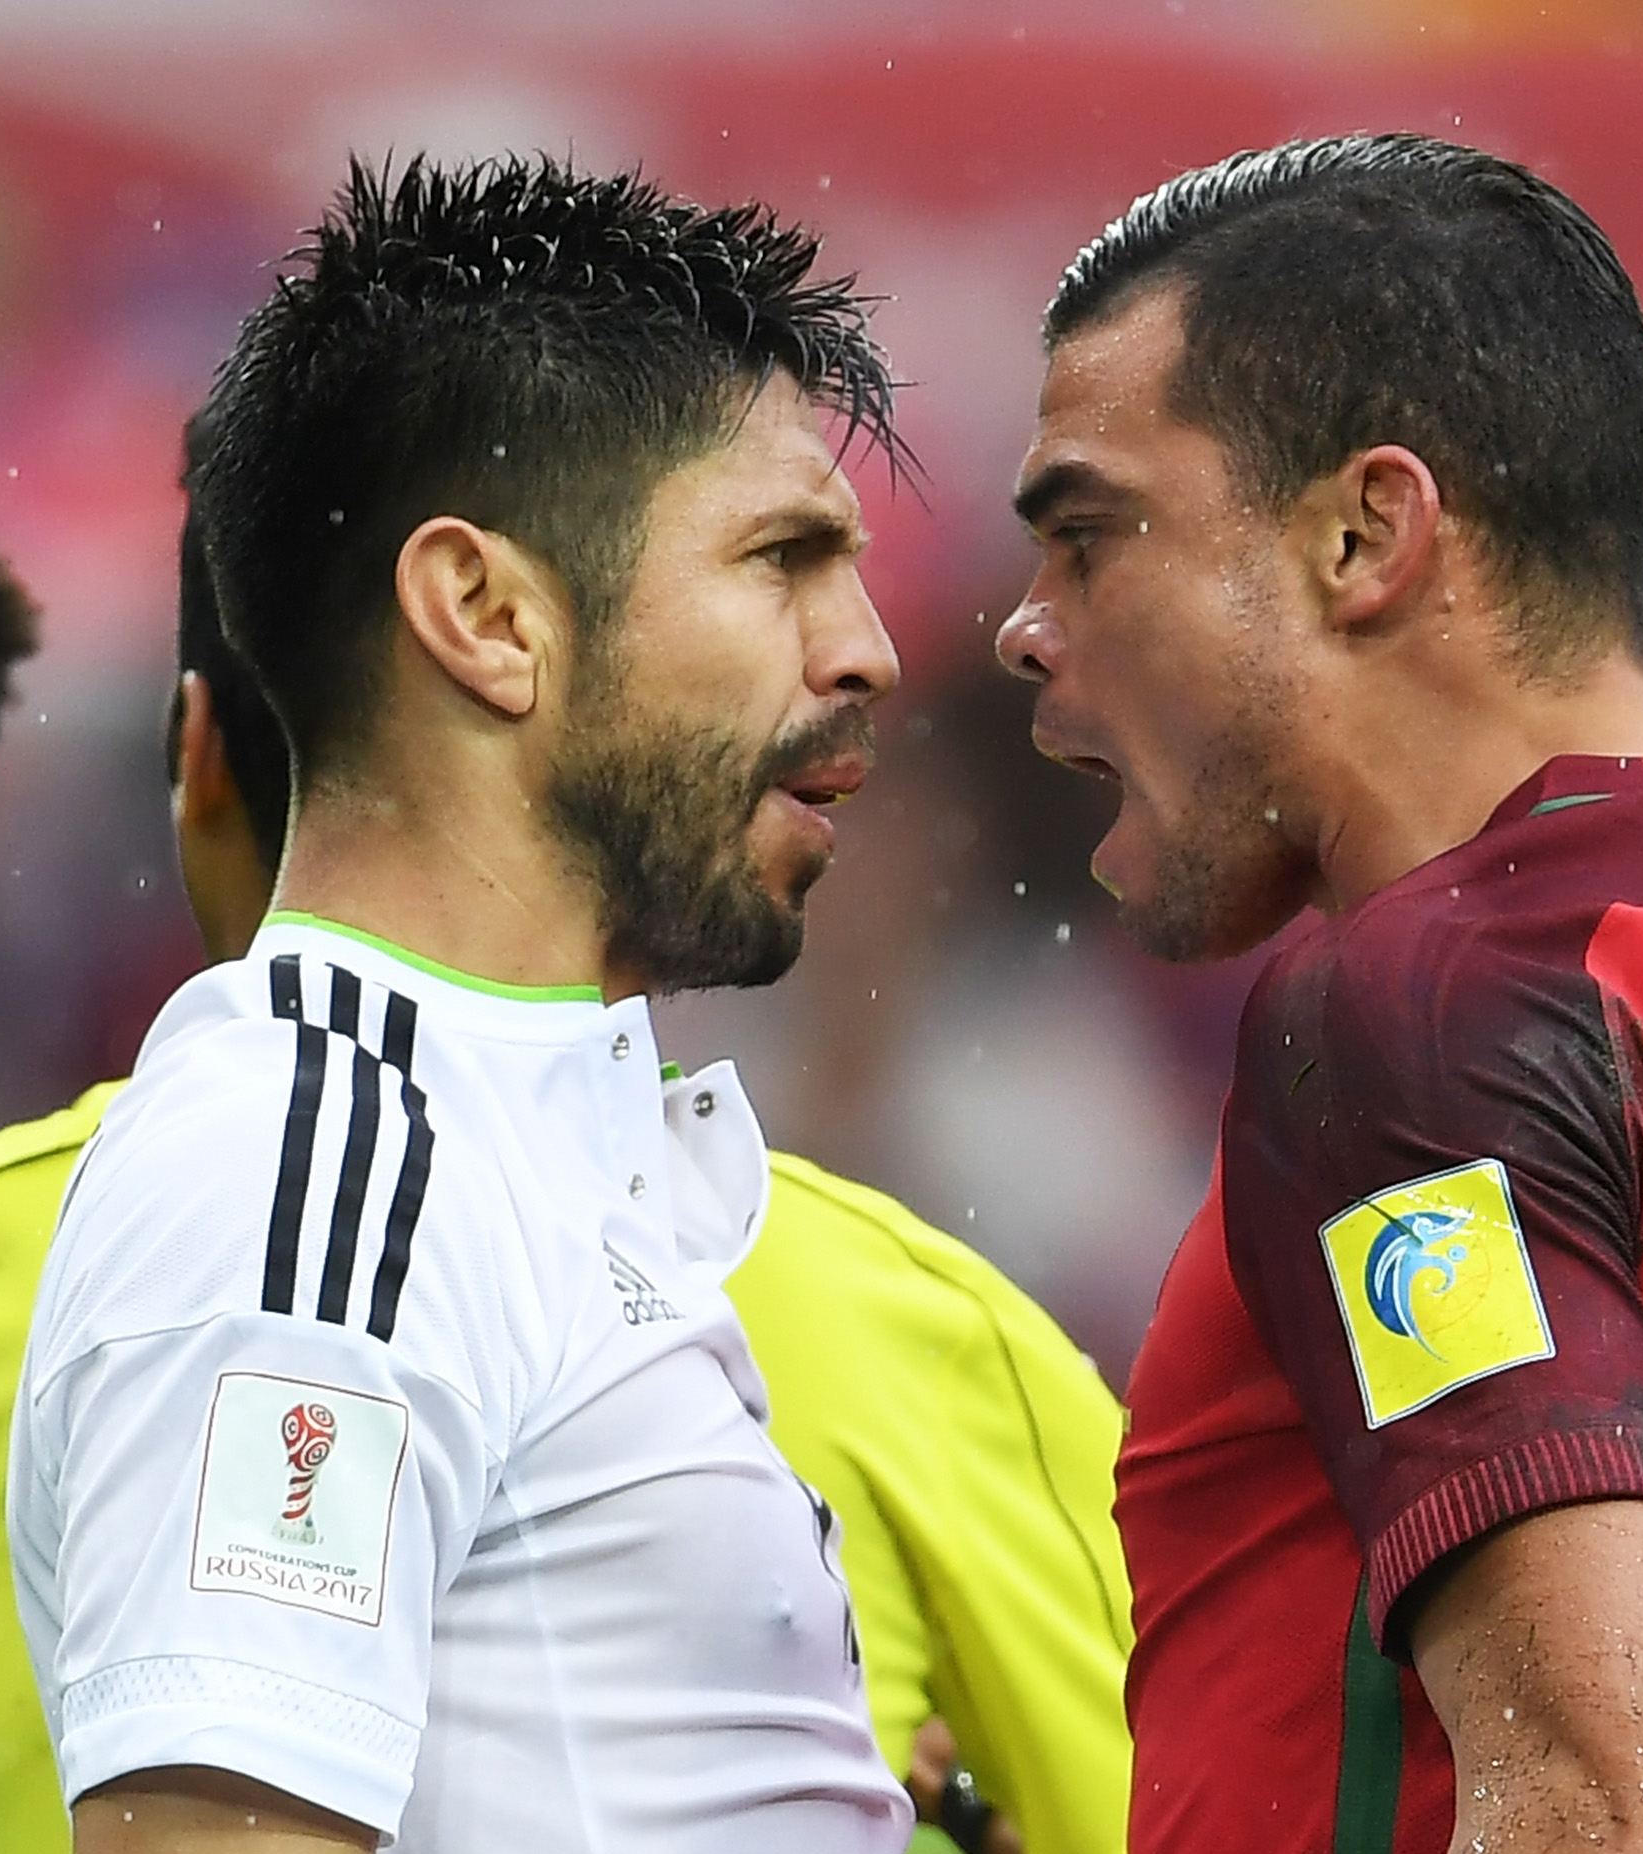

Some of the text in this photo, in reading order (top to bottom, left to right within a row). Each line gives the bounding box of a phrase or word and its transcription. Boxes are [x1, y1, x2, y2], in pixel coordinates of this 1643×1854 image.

[206, 1556, 373, 1606] RUSSIA 2017
[333, 1565, 358, 1577] CUP
